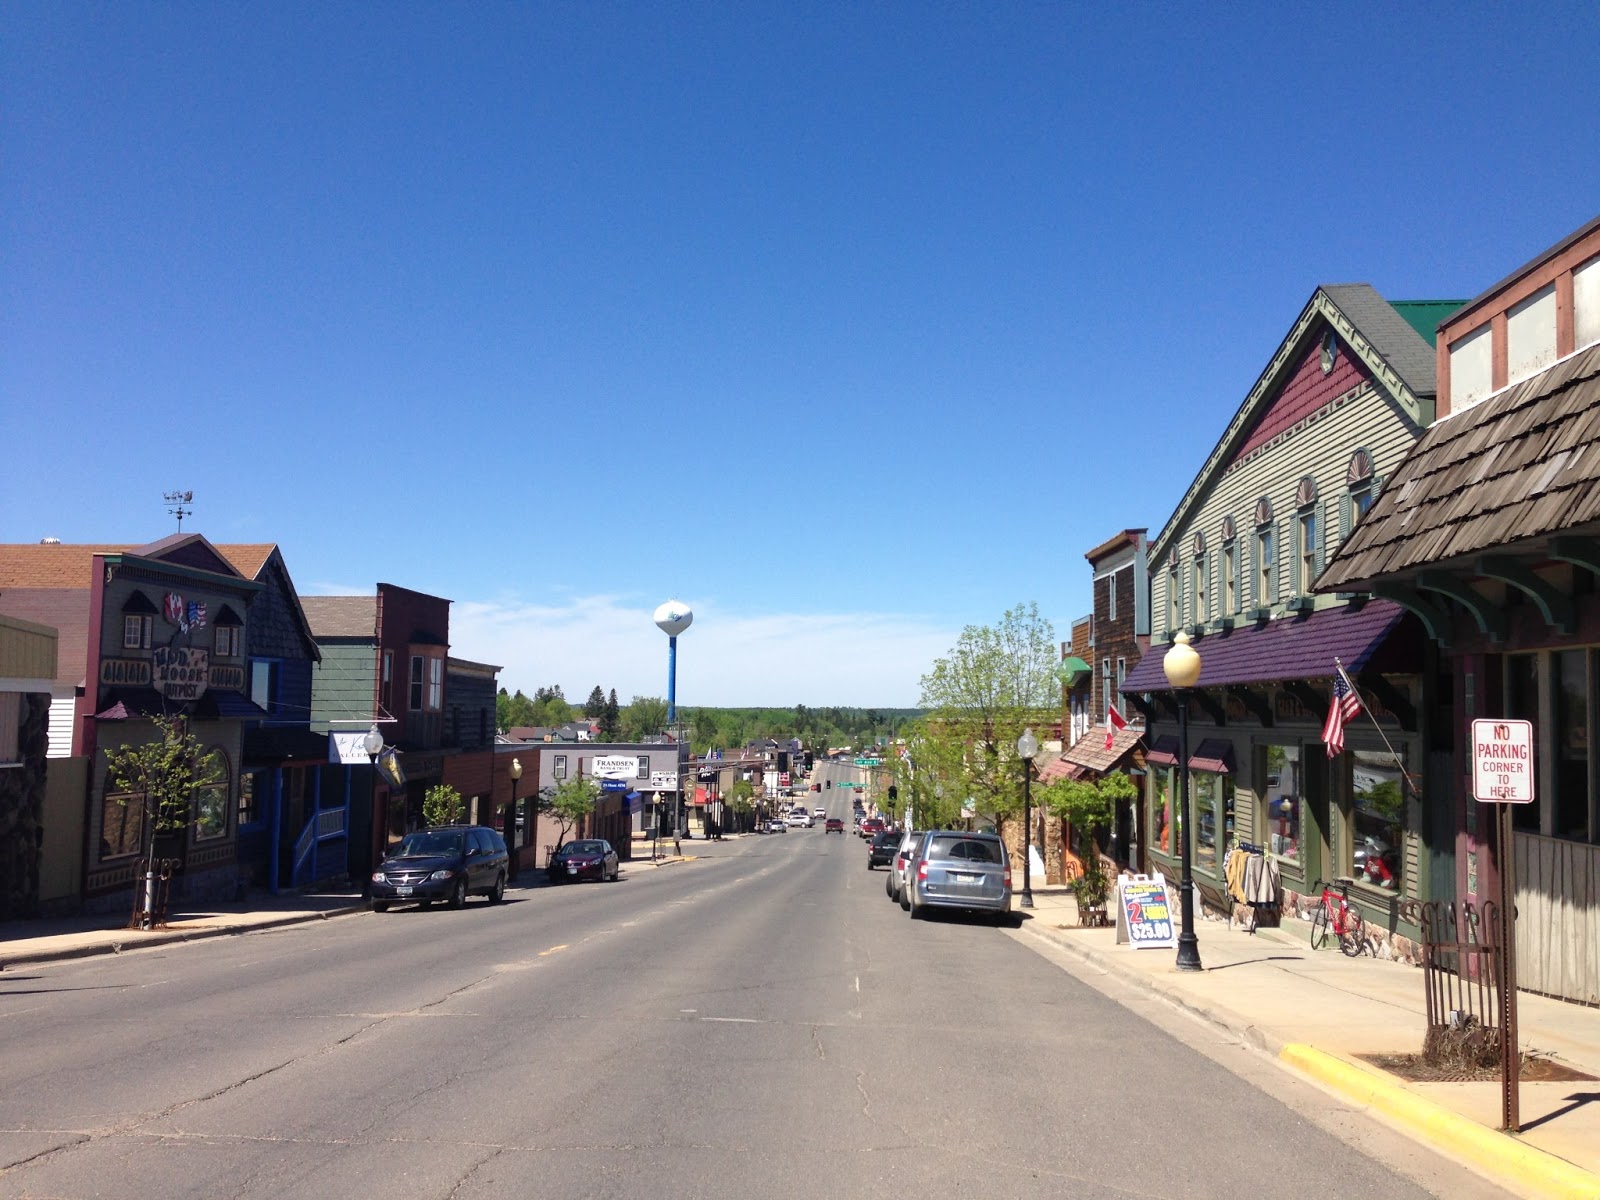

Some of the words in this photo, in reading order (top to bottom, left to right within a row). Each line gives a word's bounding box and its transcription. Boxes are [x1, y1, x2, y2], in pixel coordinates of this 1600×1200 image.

[160, 666, 203, 682] MOOSE
[164, 682, 198, 698] OUTPOST
[1494, 725, 1510, 740] NO
[1478, 743, 1527, 759] PARKING
[1483, 762, 1523, 773] CORNER
[1497, 774, 1510, 785] TO
[1490, 786, 1517, 798] HERE
[1127, 902, 1144, 924] 2
[1131, 922, 1170, 939] $25.00
